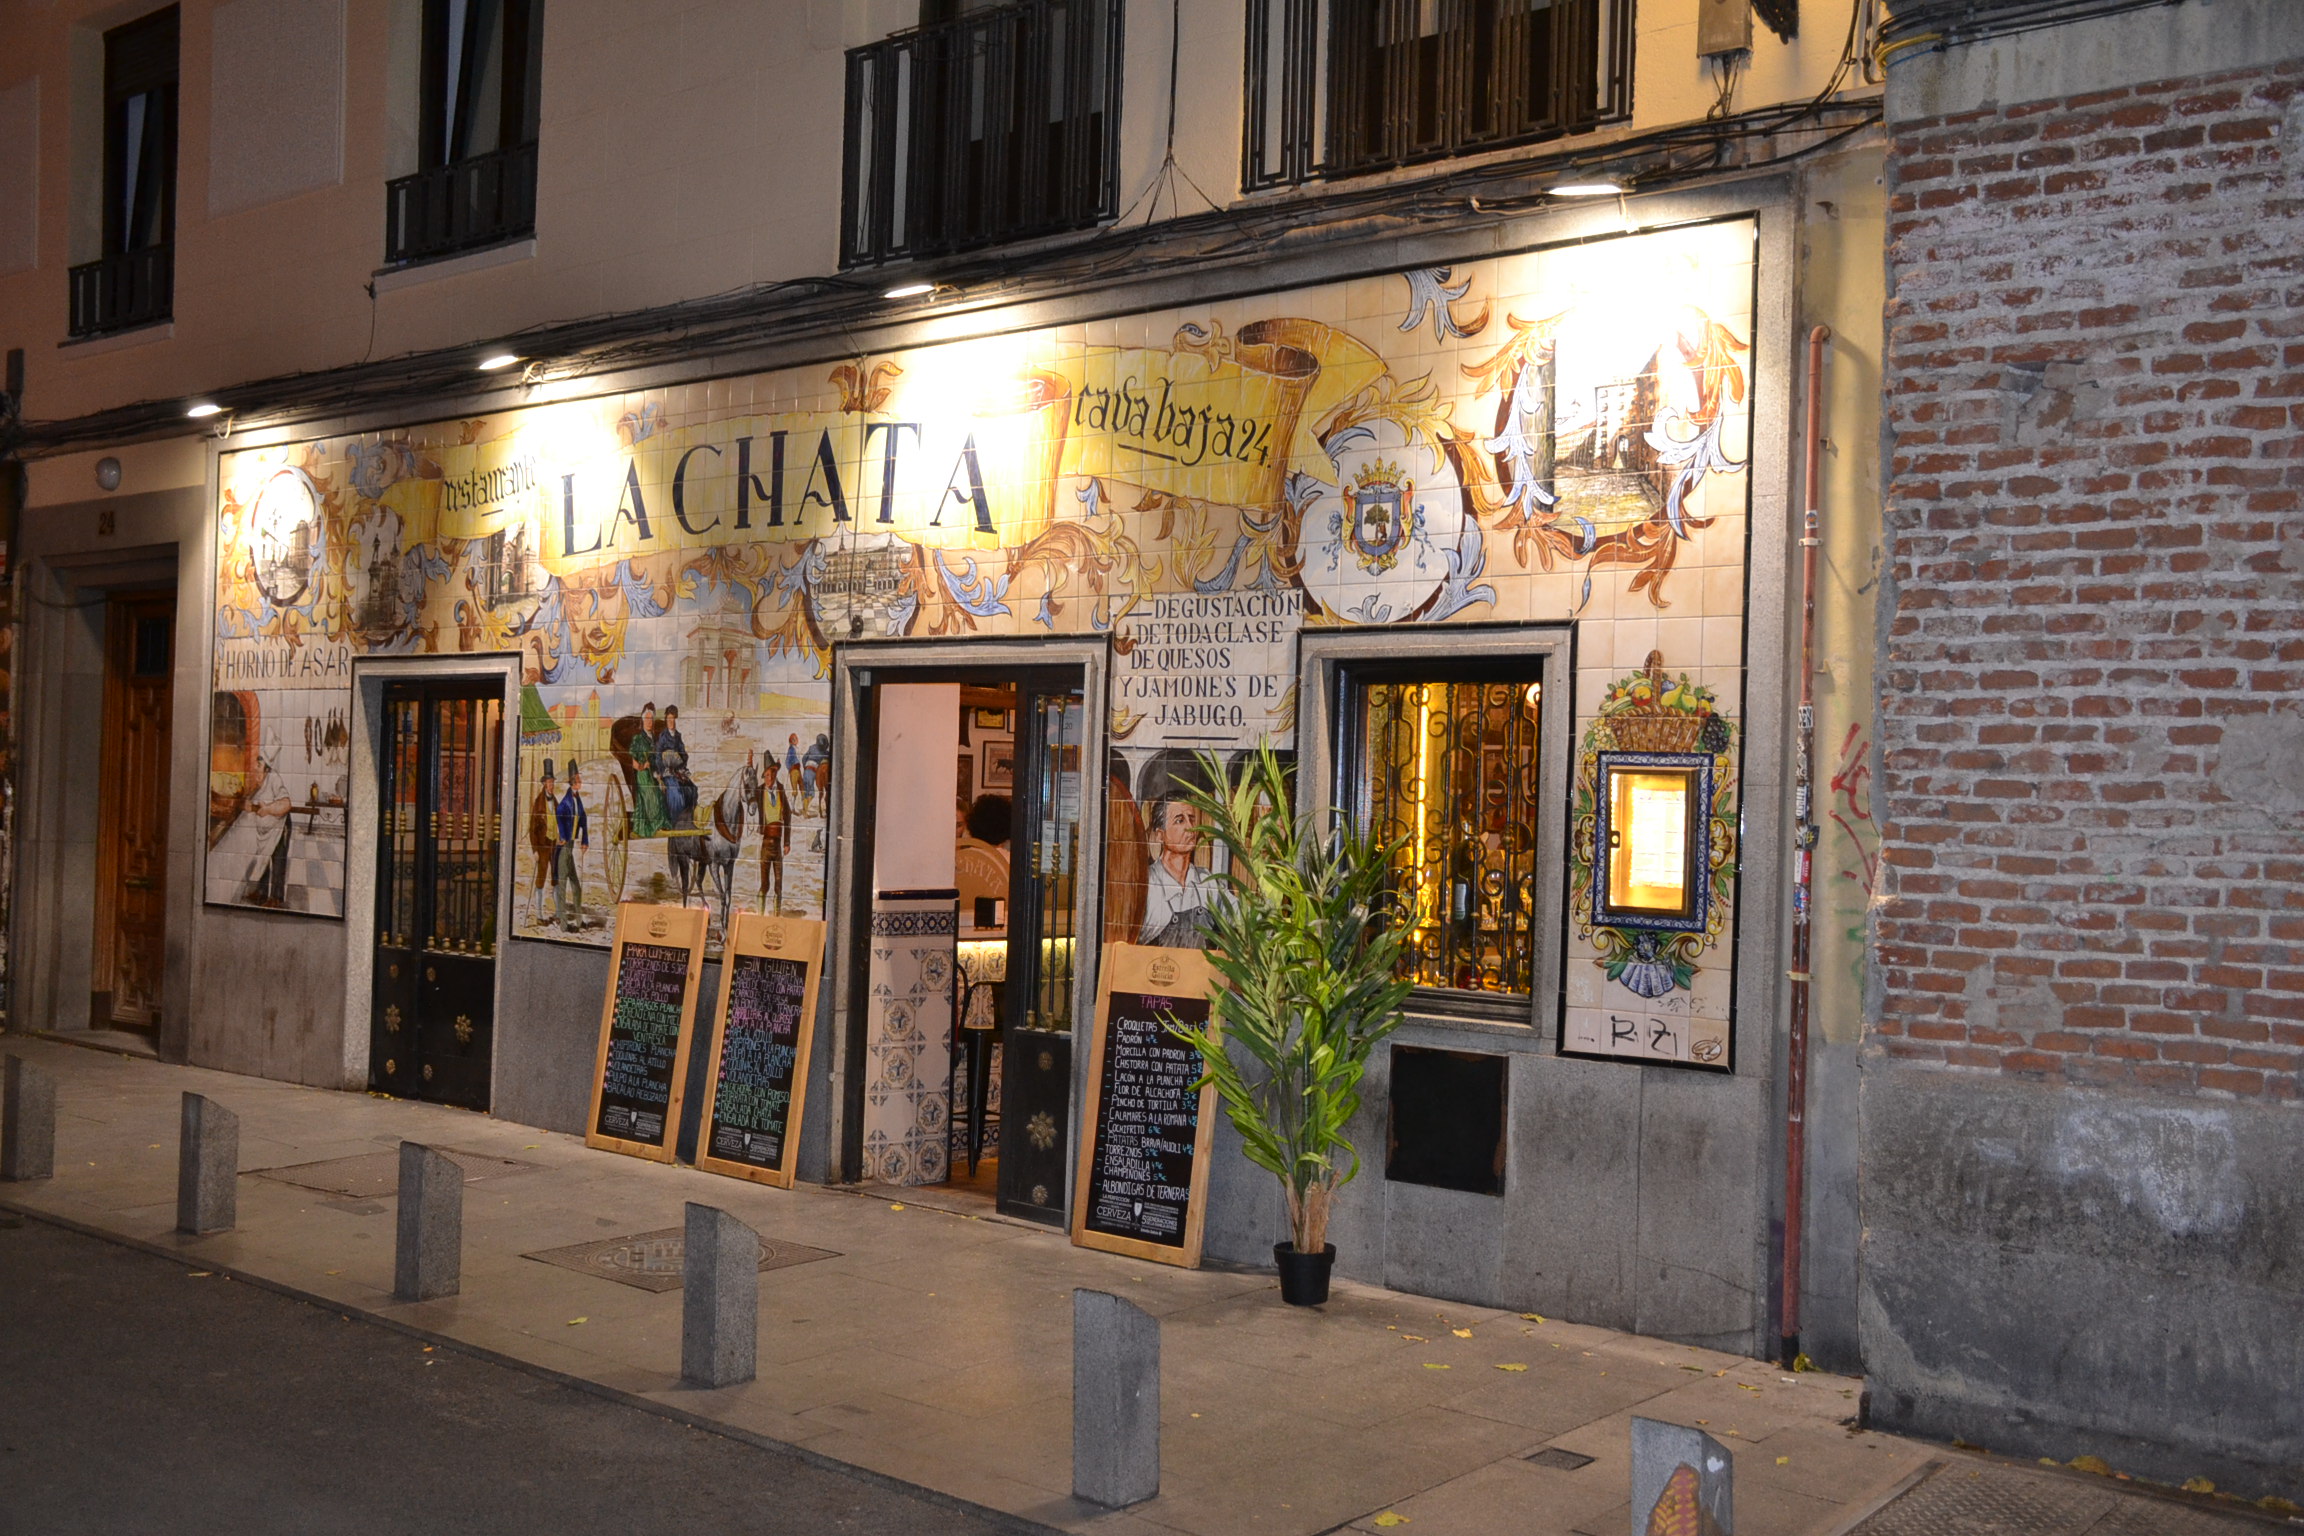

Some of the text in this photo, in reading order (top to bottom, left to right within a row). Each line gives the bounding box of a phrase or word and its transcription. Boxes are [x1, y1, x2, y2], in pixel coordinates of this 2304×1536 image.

[1153, 376, 1236, 467] baja
[562, 422, 998, 557] LA CHATA
[1155, 591, 1301, 619] DEGUSTACIÓN
[1136, 621, 1284, 645] DE TODA CLASE
[226, 646, 348, 679] HORNO DE ASAR
[1131, 647, 1231, 671] DE QUESOS
[1119, 675, 1278, 698] Y JAMONES DE
[1155, 704, 1246, 726] JABUGO.
[627, 944, 647, 957] PARA
[661, 962, 670, 971] DE
[745, 958, 797, 975] SIN GLUTEN
[641, 990, 649, 999] DE
[651, 992, 668, 1002] POLLO
[1139, 996, 1173, 1009] TAPAS
[756, 1021, 764, 1030] LA
[766, 1023, 791, 1033] PLANCHA
[1117, 1017, 1158, 1033] CROQUETAS
[1117, 1031, 1142, 1044] PADRÓN
[651, 1046, 677, 1057] PLANCHA
[727, 1047, 792, 1067] PULPO A LA PLANCHA
[1116, 1045, 1146, 1058] MORCILLA
[1149, 1048, 1160, 1058] CON
[639, 1056, 646, 1064] AL
[755, 1063, 762, 1073] AL
[1115, 1056, 1149, 1070] CHISTORRA
[1151, 1061, 1163, 1072] CON
[1166, 1063, 1190, 1074] PATATA
[608, 1071, 667, 1091] PULPO A LA PLANCHA
[1115, 1070, 1135, 1083] LACÓN
[1139, 1074, 1143, 1083] A
[1147, 1075, 1154, 1084] LA
[1157, 1074, 1183, 1087] PLANCHA
[607, 1082, 667, 1103] BACALAO REBOZADO
[754, 1087, 766, 1098] CON
[1114, 1083, 1129, 1094] FLOR
[1132, 1086, 1141, 1096] DE
[1145, 1085, 1181, 1099] ALCACHOFA
[720, 1102, 772, 1119] ENSALADA CHATA
[749, 1097, 759, 1106] CON
[760, 1100, 781, 1110] TOMATE
[1112, 1094, 1135, 1107] PINCHO
[1137, 1099, 1144, 1108] DE
[1148, 1098, 1178, 1111] TORTILLA
[605, 1115, 629, 1126] CERVEZA
[719, 1112, 783, 1133] ENSALADA DE TOMATE
[1109, 1107, 1147, 1123] CALAMARES
[1148, 1113, 1153, 1123] A
[1154, 1113, 1163, 1124] LA
[1164, 1113, 1187, 1127] ROMANA
[1108, 1121, 1145, 1135] COCHIFRITO
[717, 1137, 742, 1148] CERVEZA
[1107, 1132, 1138, 1146] PATATAS
[1105, 1144, 1143, 1158] TORREZNOS
[1105, 1155, 1150, 1170] ENSALADILLA
[1102, 1179, 1144, 1197] ALBONDIGAS
[1146, 1184, 1156, 1198] DE
[1157, 1185, 1185, 1202] TERNERA
[1097, 1207, 1131, 1220] CERVEZA
